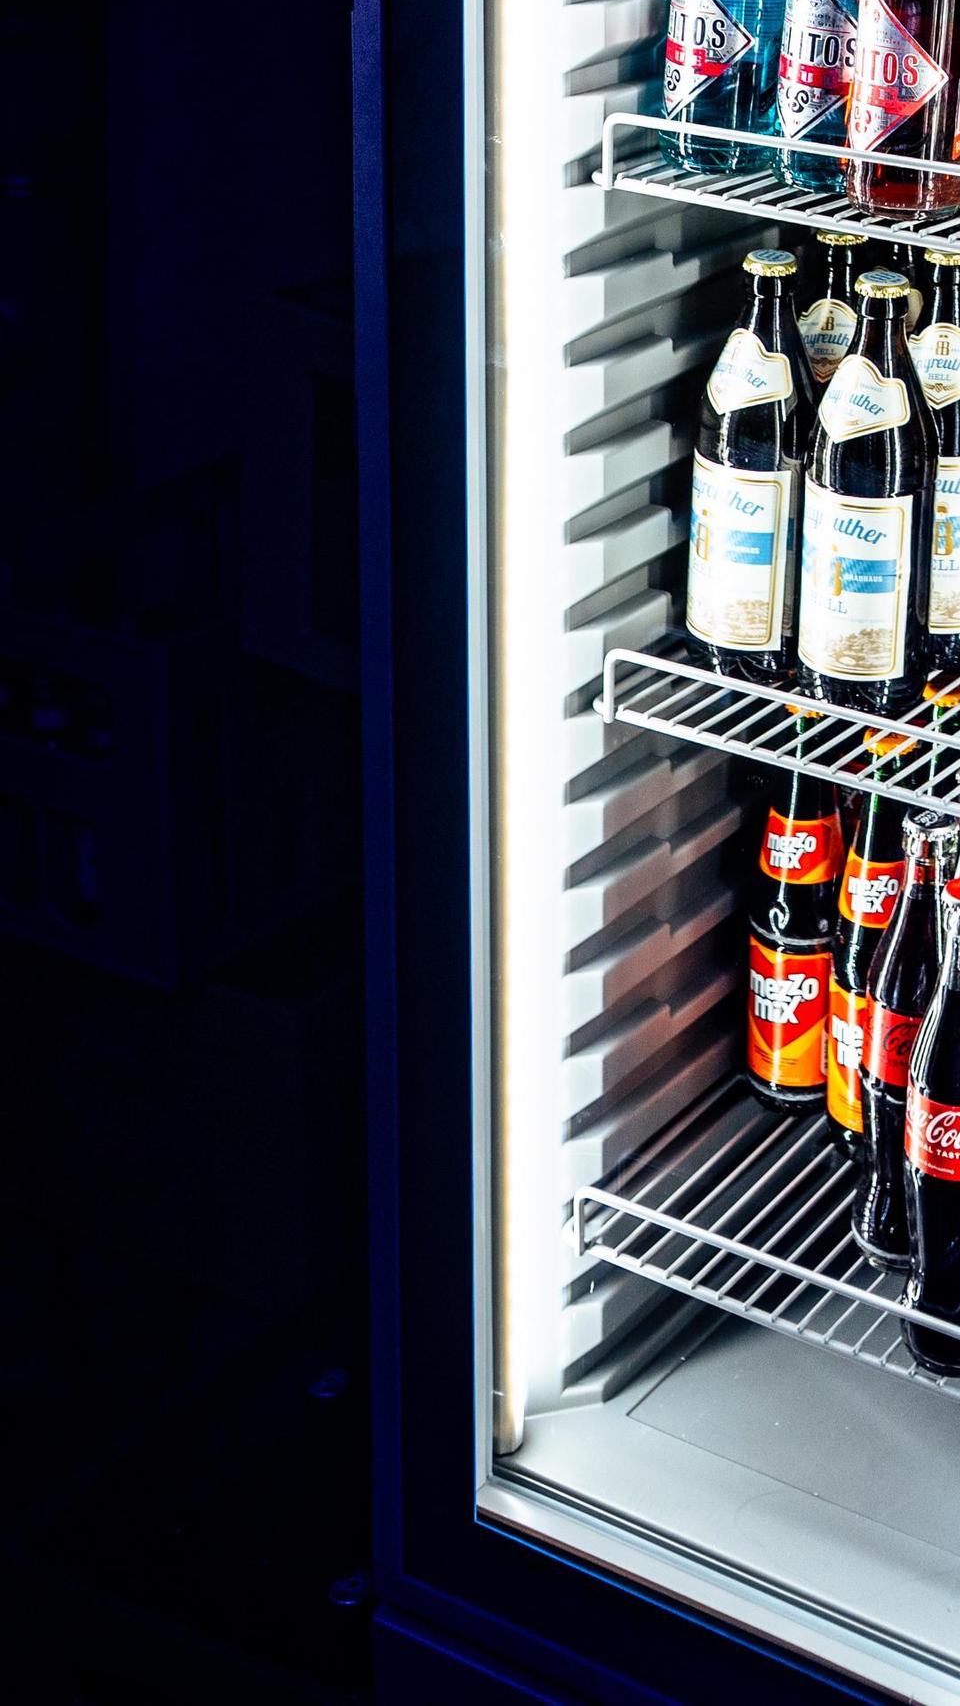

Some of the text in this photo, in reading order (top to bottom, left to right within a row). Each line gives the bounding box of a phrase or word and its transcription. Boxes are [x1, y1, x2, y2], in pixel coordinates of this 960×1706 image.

[927, 372, 952, 381] HELL
[767, 831, 817, 853] mezzo
[769, 850, 802, 870] mix
[847, 874, 900, 897] mezzo
[750, 968, 820, 1001] mezzo
[754, 994, 800, 1025] mix
